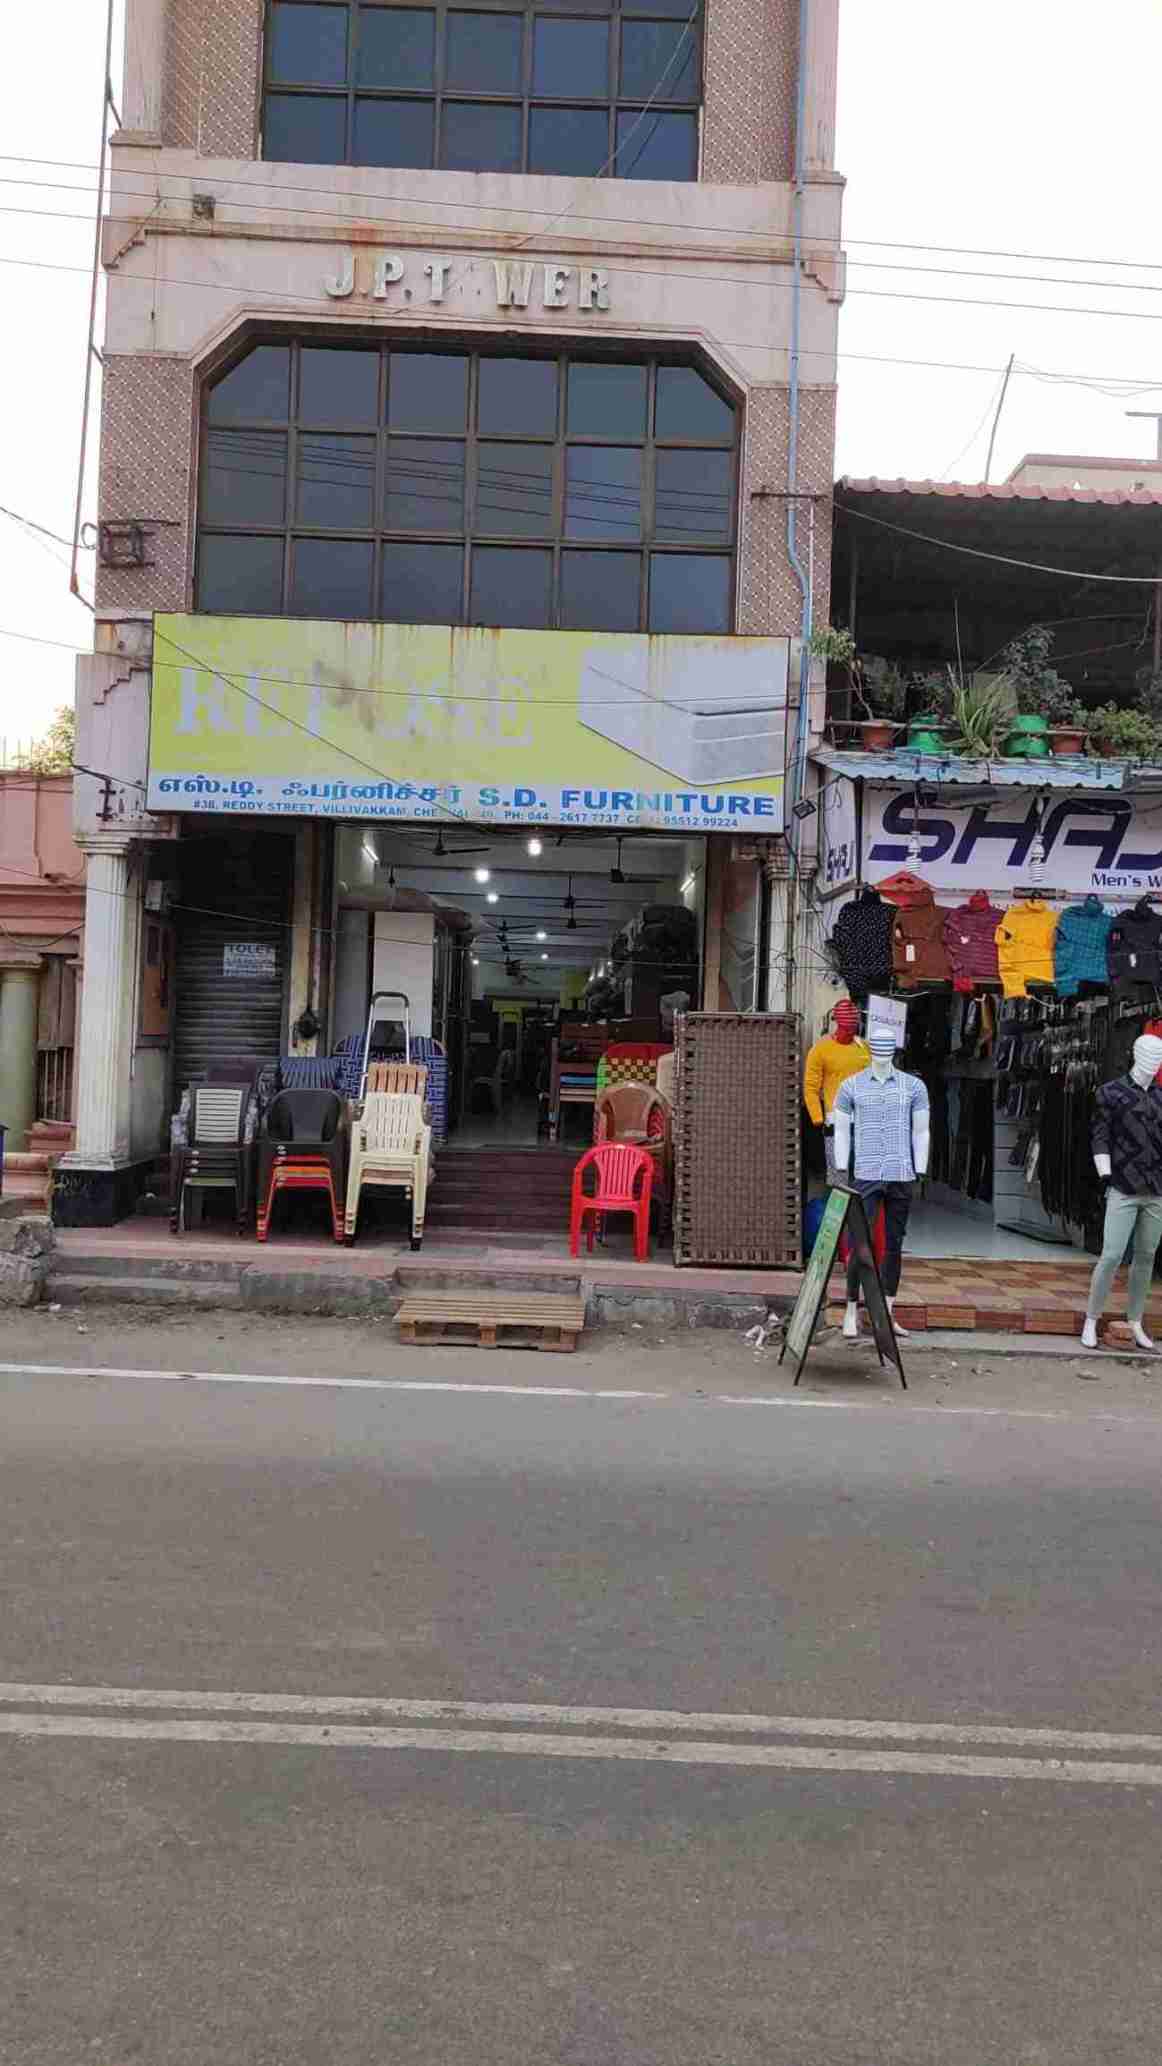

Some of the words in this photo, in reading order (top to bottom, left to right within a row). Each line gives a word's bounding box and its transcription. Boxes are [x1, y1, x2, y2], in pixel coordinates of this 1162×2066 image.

[223, 799, 264, 811] REDDY
[478, 787, 548, 809] S.D.
[561, 789, 775, 817] FURNITURE
[1091, 872, 1142, 887] Men's
